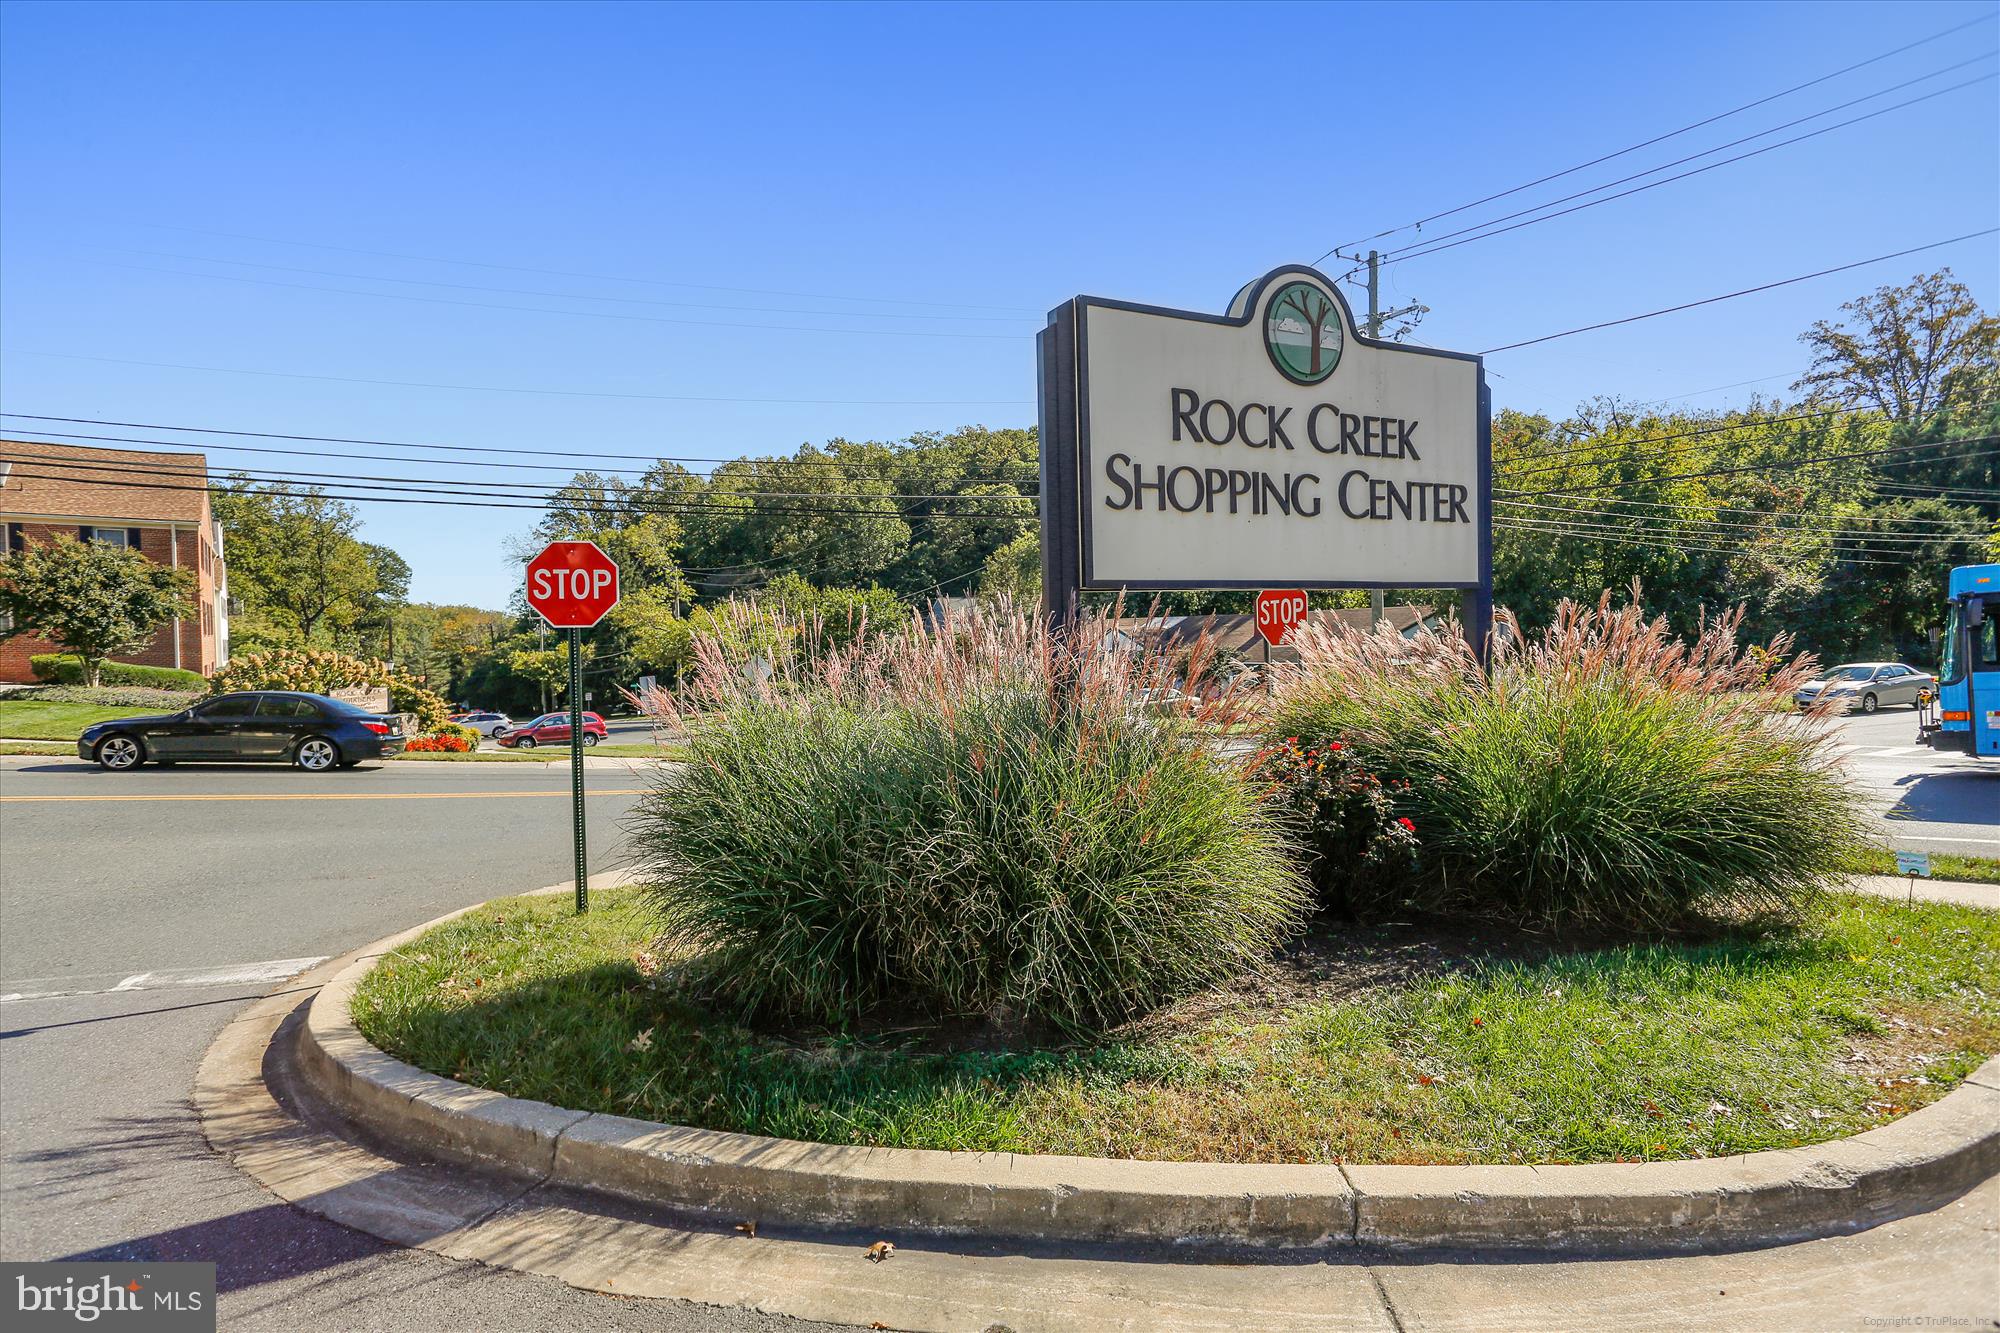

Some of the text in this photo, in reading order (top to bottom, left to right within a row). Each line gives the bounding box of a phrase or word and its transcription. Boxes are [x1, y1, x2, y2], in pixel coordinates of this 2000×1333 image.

[1171, 387, 1421, 461] ROCK CREEK
[1105, 453, 1470, 524] SHOPPING CENTER
[533, 568, 612, 600] STOP
[1260, 598, 1304, 625] STOP
